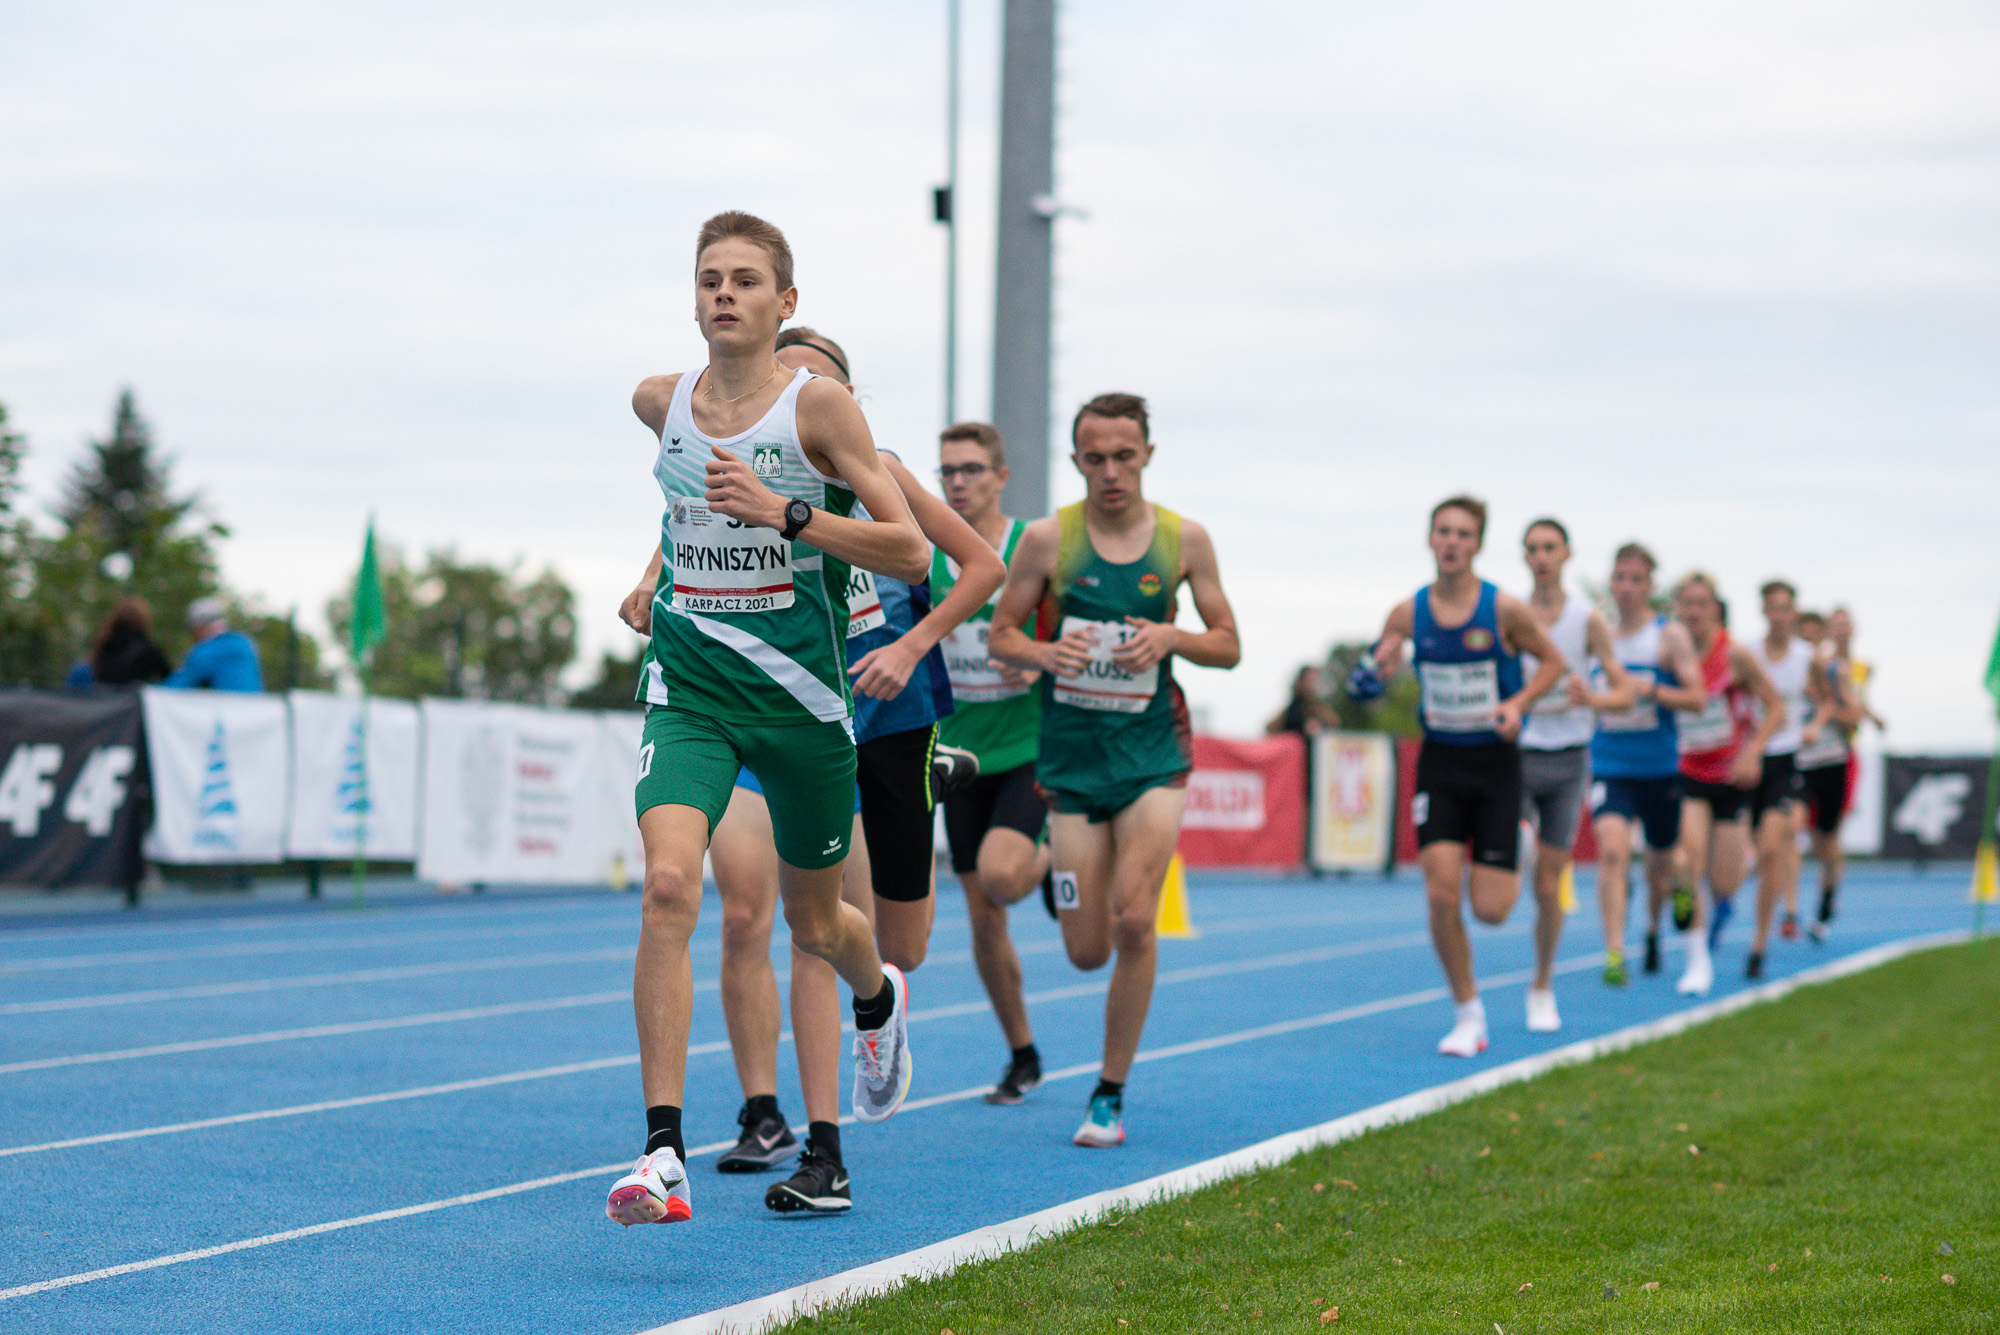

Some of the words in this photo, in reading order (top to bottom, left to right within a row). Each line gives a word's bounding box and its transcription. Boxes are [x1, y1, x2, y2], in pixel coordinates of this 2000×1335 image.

[677, 543, 786, 571] HRYNISZYN
[685, 597, 742, 610] KARPACZ
[745, 597, 774, 610] 2021
[640, 748, 651, 774] 1
[62, 744, 137, 837] 4F
[1892, 772, 1973, 844] 4F
[1061, 879, 1075, 903] 0
